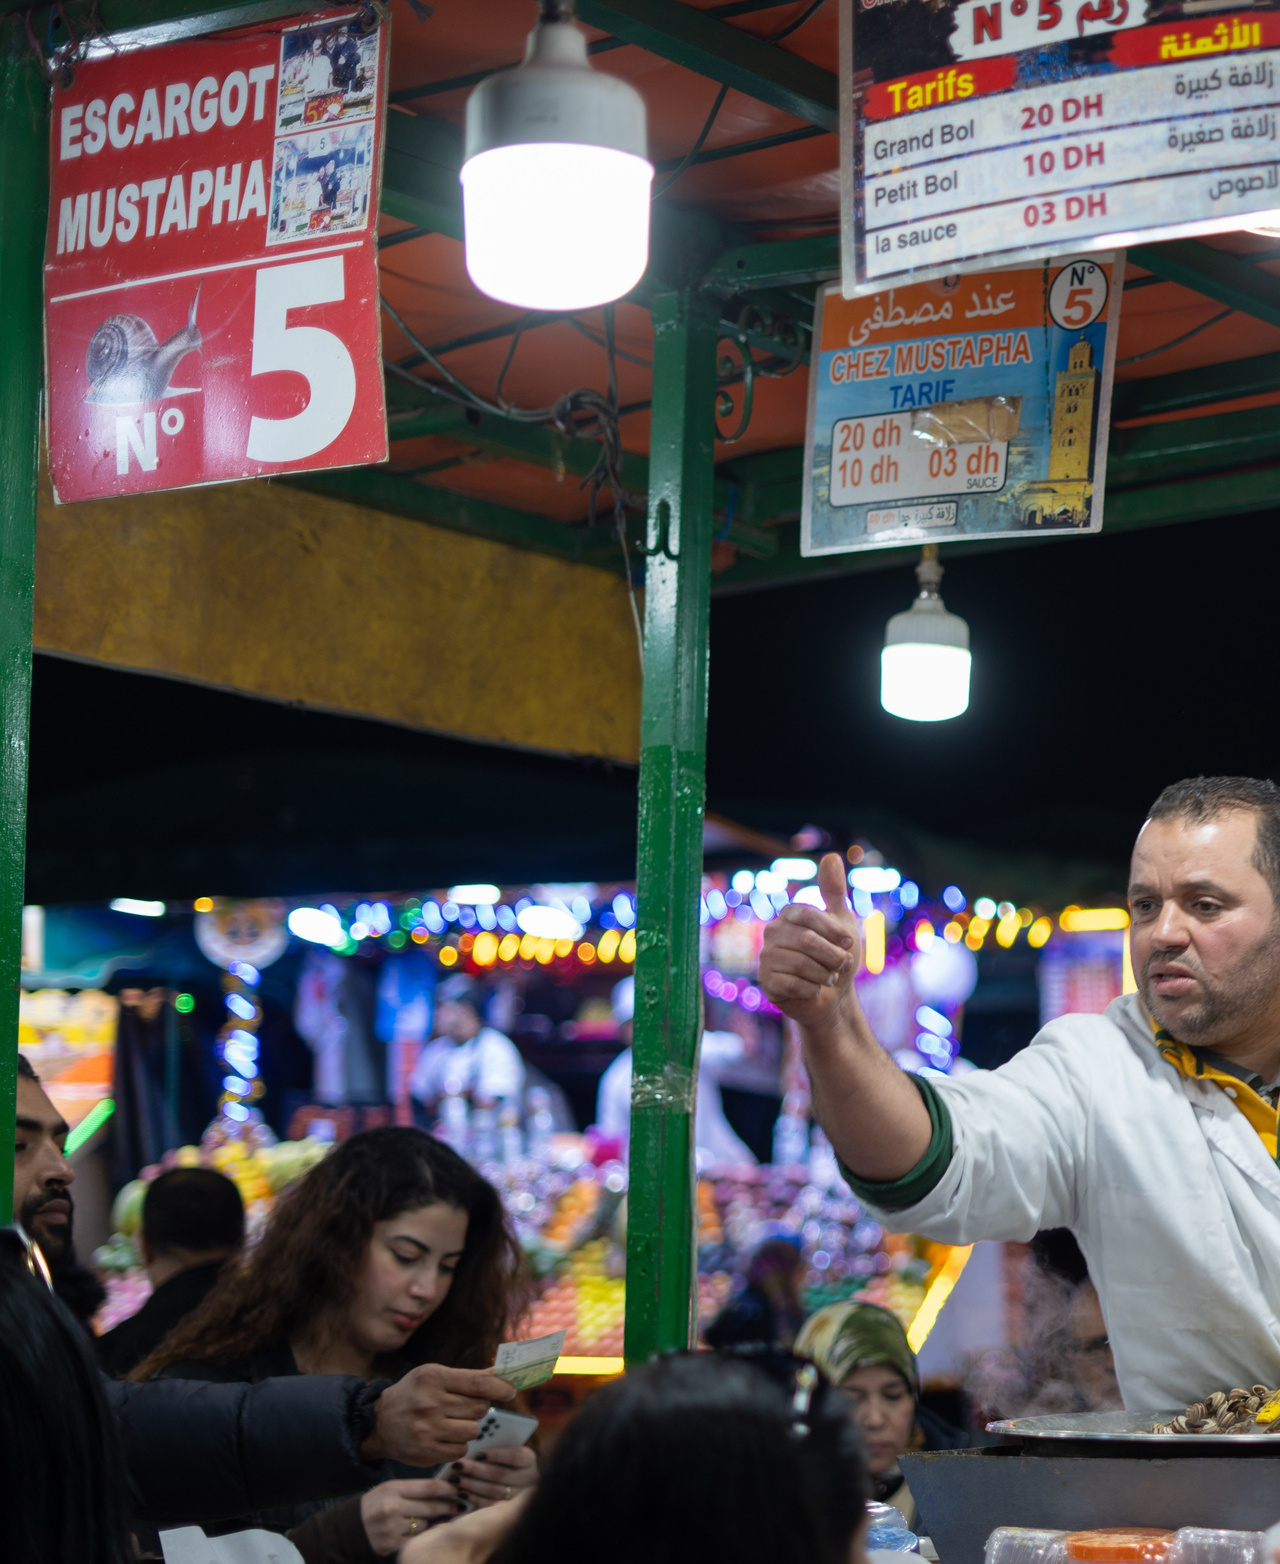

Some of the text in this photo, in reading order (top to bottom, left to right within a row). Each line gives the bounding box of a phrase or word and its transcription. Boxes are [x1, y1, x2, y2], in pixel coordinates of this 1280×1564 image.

[1161, 19, 1260, 59] الأثمنة
[888, 69, 975, 113] Tarifs
[1175, 61, 1274, 99] زلافة كبيرة
[60, 64, 275, 161] ESCARGOT
[1021, 94, 1104, 130] 20 DH
[874, 119, 974, 161] Grand Bol
[1168, 114, 1276, 153] زلافة صغيرة
[1023, 141, 1105, 177] 10 DH
[875, 170, 958, 207] Petit Bol
[1209, 164, 1279, 200] لاصوص
[56, 159, 266, 255] MUSTAPHA
[1023, 192, 1107, 227] 03 DH
[875, 222, 957, 254] la sauce
[1069, 266, 1095, 287] N°
[965, 283, 1016, 319] عند
[1063, 288, 1094, 327] 5
[116, 255, 356, 476] N° 5
[830, 331, 1033, 384] CHEZ MUSTAPHA
[889, 379, 956, 409] TARIF
[839, 418, 901, 453] 20 dh
[839, 454, 898, 488] 10 dh
[928, 445, 999, 478] 03 dh
[967, 476, 999, 489] SAUCE
